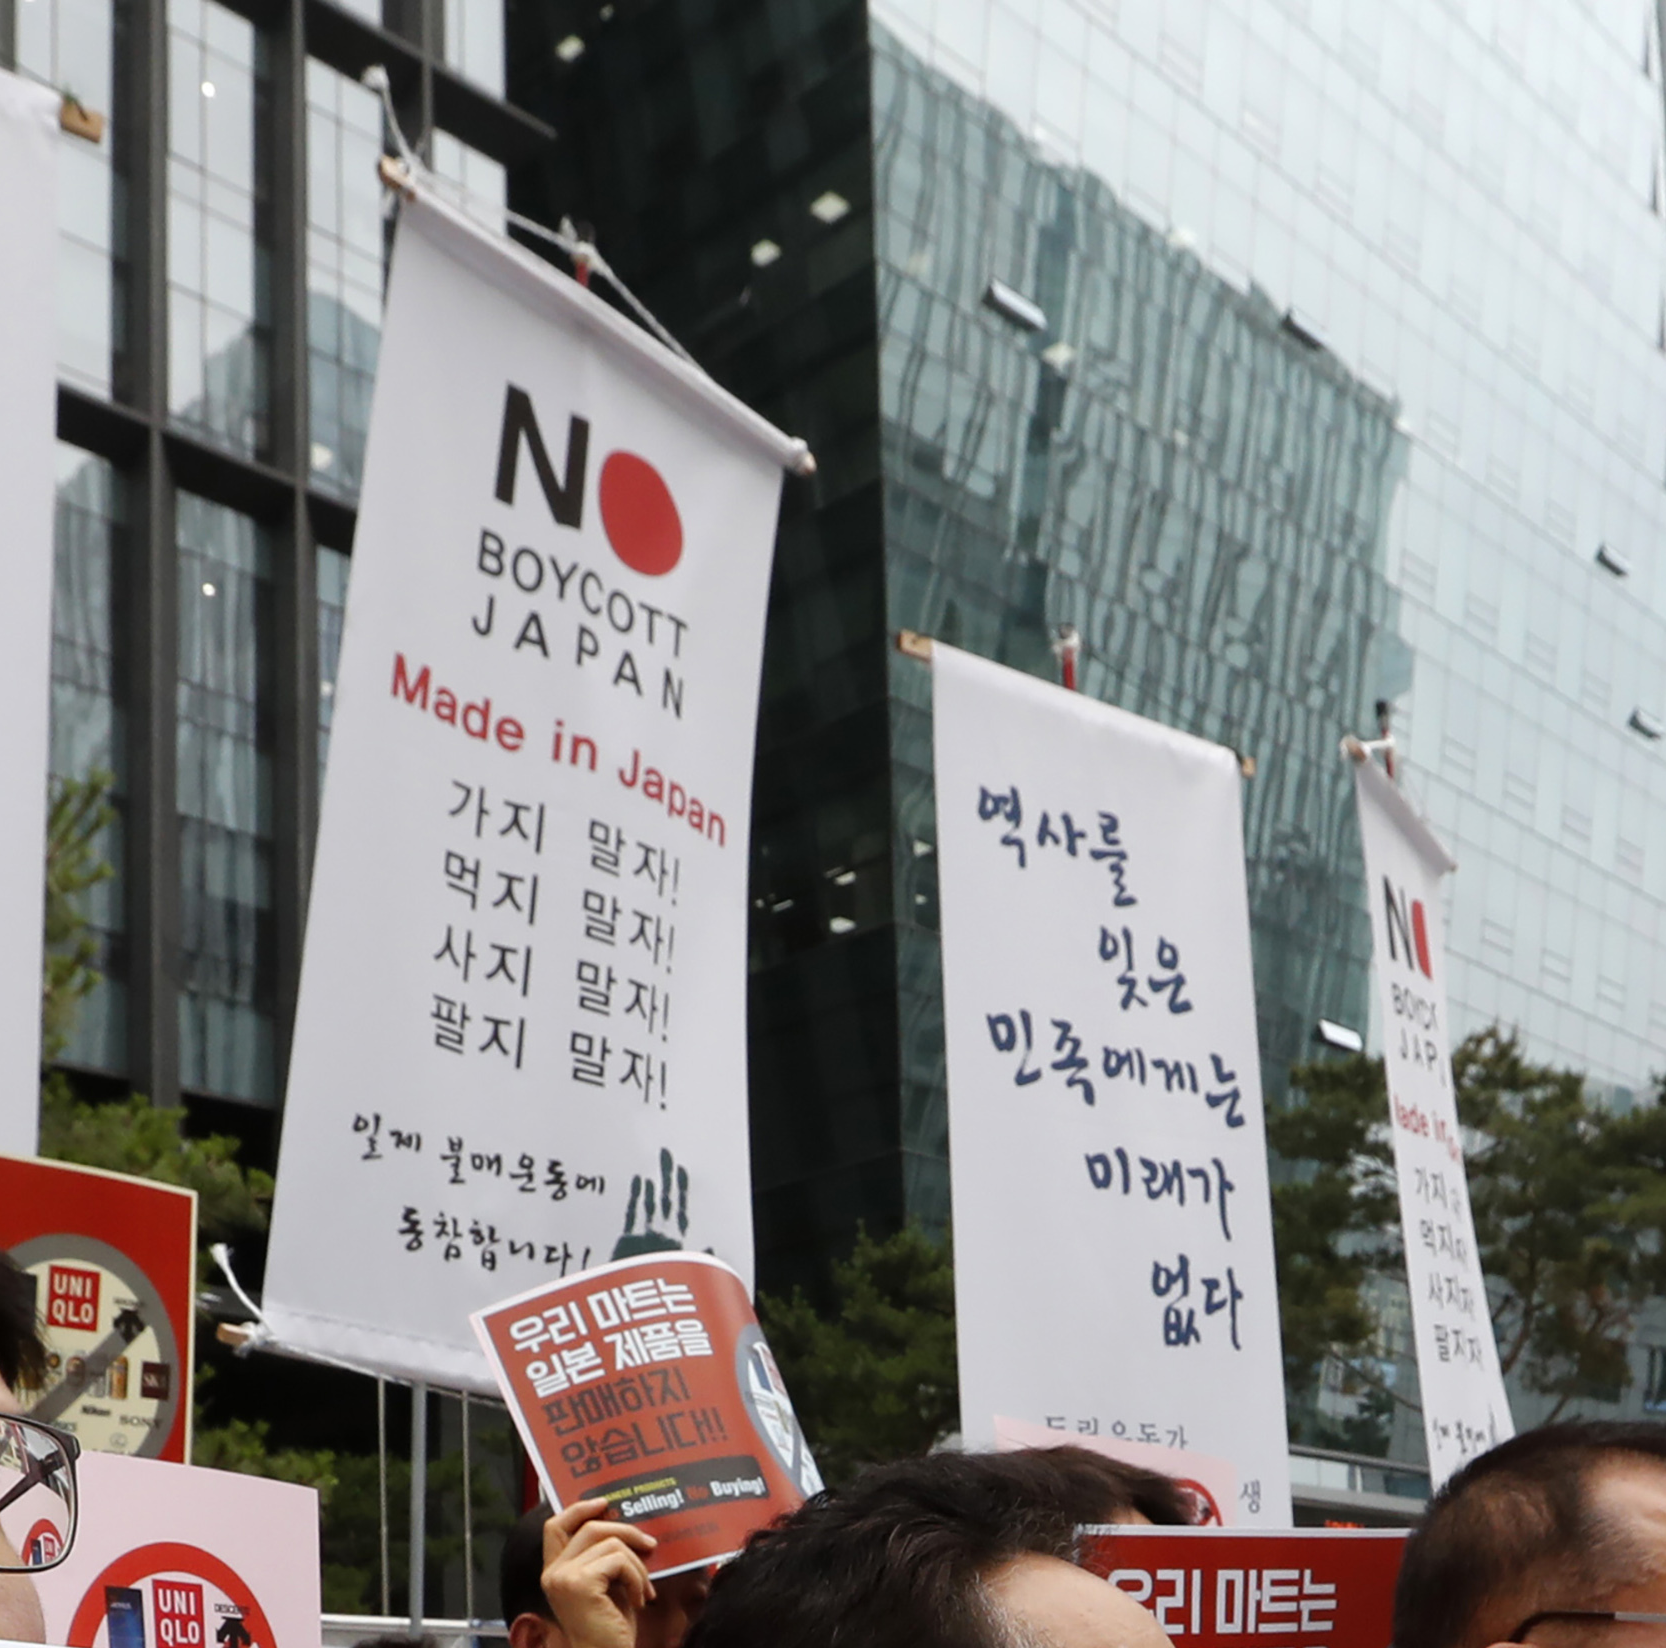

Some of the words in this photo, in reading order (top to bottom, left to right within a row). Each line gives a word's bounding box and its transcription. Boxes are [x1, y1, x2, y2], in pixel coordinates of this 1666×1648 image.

[478, 528, 688, 658] BOYCOTT
[472, 596, 685, 720] JAPAN
[391, 652, 524, 752] Made
[552, 719, 597, 772] in
[618, 750, 727, 848] Japan
[448, 779, 546, 855] 가지
[588, 818, 681, 906] 말자!
[977, 785, 1139, 908] 역사를
[444, 850, 539, 927] 먹지
[582, 889, 675, 974] 말자!
[433, 925, 533, 998] 사지
[576, 959, 670, 1043] 말자!
[1098, 926, 1194, 1014] 잊은
[430, 994, 527, 1070] 팔지
[569, 1031, 668, 1111] 말자!
[987, 1008, 1246, 1128] 민족에게는
[351, 1112, 423, 1160] 일제
[439, 1136, 606, 1201] 불매운동에
[1085, 1147, 1236, 1242] 미래가
[53, 1273, 93, 1299] UNI
[398, 1206, 593, 1278] 동참합니다!
[52, 1298, 95, 1326] QLO
[509, 1301, 588, 1353] 우리
[586, 1277, 697, 1331] 마트는
[1151, 1253, 1244, 1351] 없다
[525, 1344, 605, 1399] 일본
[602, 1318, 714, 1371] 제품을
[542, 1366, 691, 1437] 판매하지
[560, 1407, 730, 1479] 않습니다!!
[620, 1489, 685, 1518] Selling!
[710, 1476, 767, 1498] Buying!
[157, 1587, 197, 1616] UNI
[159, 1618, 201, 1647] QLO
[1215, 1568, 1337, 1635] 마트는
